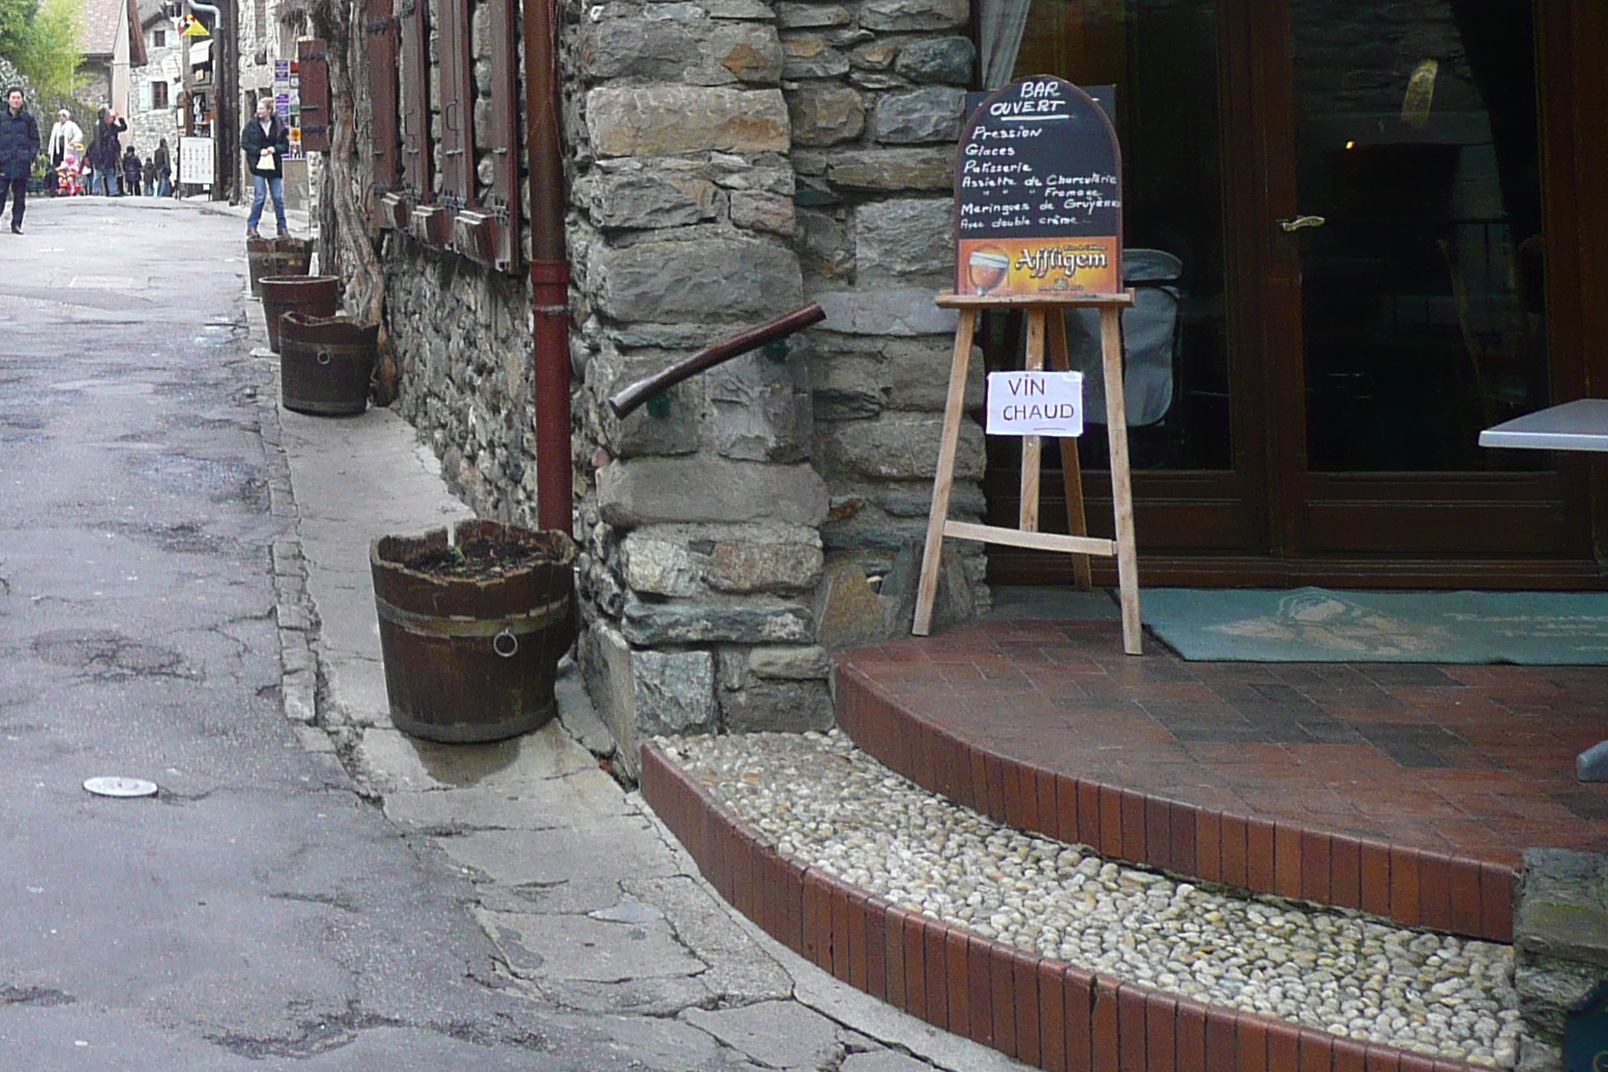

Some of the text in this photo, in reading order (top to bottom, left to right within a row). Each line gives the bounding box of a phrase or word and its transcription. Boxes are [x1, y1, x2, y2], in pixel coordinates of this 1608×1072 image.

[1020, 81, 1062, 98] BAR
[990, 100, 1066, 116] OUVERT
[965, 144, 1016, 157] Glaces
[962, 176, 1018, 188] Assiette
[1024, 176, 1043, 187] de
[961, 203, 1031, 216] Meringues
[1039, 199, 1055, 211] de
[991, 215, 1031, 228] double
[1014, 247, 1108, 279] Affligem
[1003, 403, 1075, 421] CHAUD
